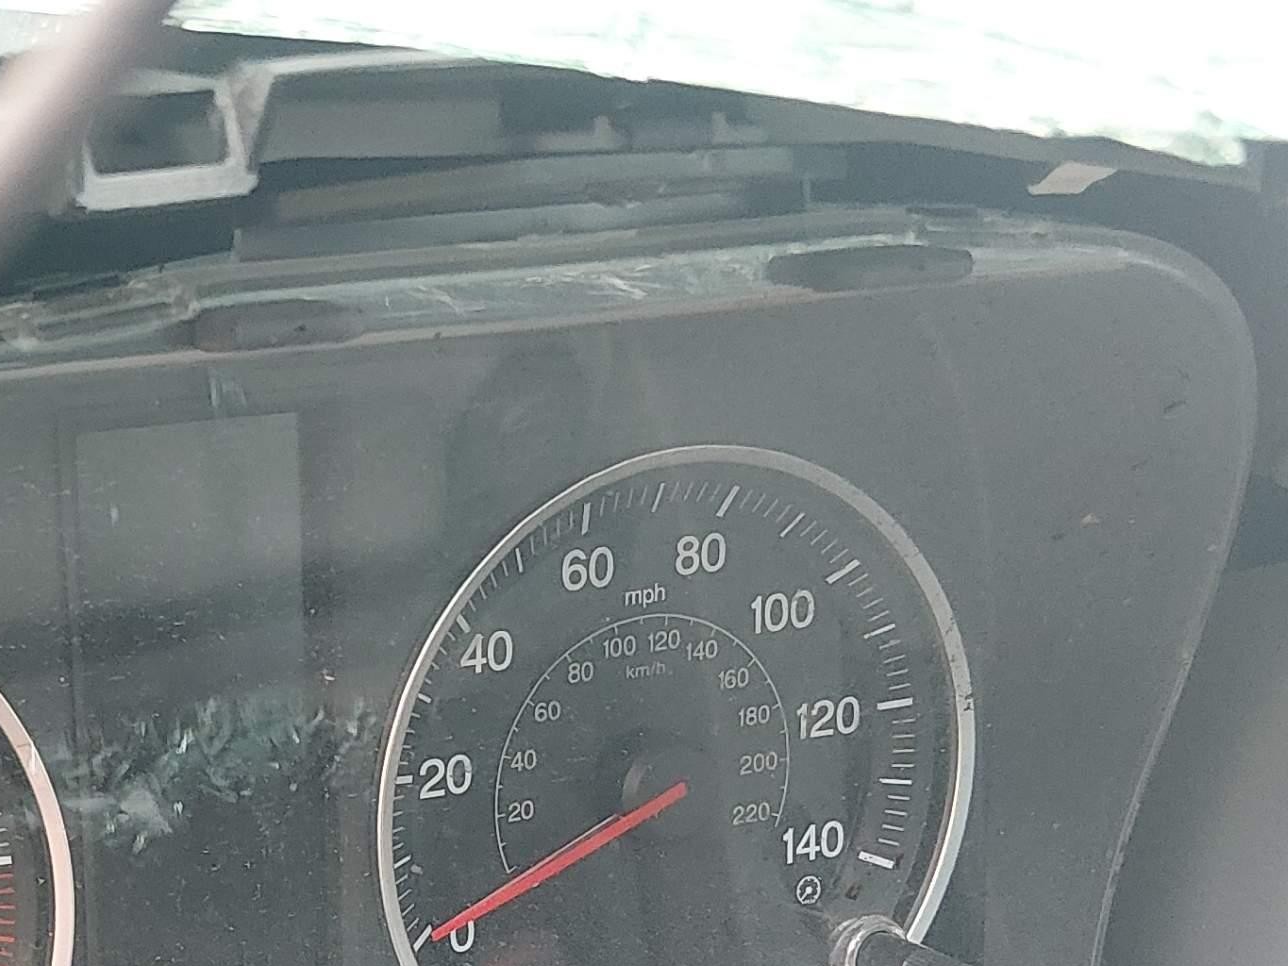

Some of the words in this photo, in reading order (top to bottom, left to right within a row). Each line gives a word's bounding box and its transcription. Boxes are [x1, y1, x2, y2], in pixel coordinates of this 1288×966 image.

[675, 533, 726, 576] 80
[562, 546, 614, 591] 60
[624, 582, 666, 609] mph
[751, 590, 815, 634] 100
[461, 630, 513, 674] 40
[603, 635, 636, 659] 100
[647, 629, 681, 653] 120
[686, 639, 718, 661] 140
[567, 661, 594, 684] 80
[625, 661, 666, 679] km/h
[718, 668, 749, 690] 160
[534, 701, 561, 722] 60
[738, 705, 770, 727] 180
[797, 696, 860, 740] 120
[511, 749, 537, 772] 40
[739, 752, 777, 776] 200
[419, 754, 472, 799] 20
[507, 800, 534, 823] 20
[732, 802, 770, 826] 220
[782, 820, 844, 864] 140
[450, 920, 475, 953] 0
